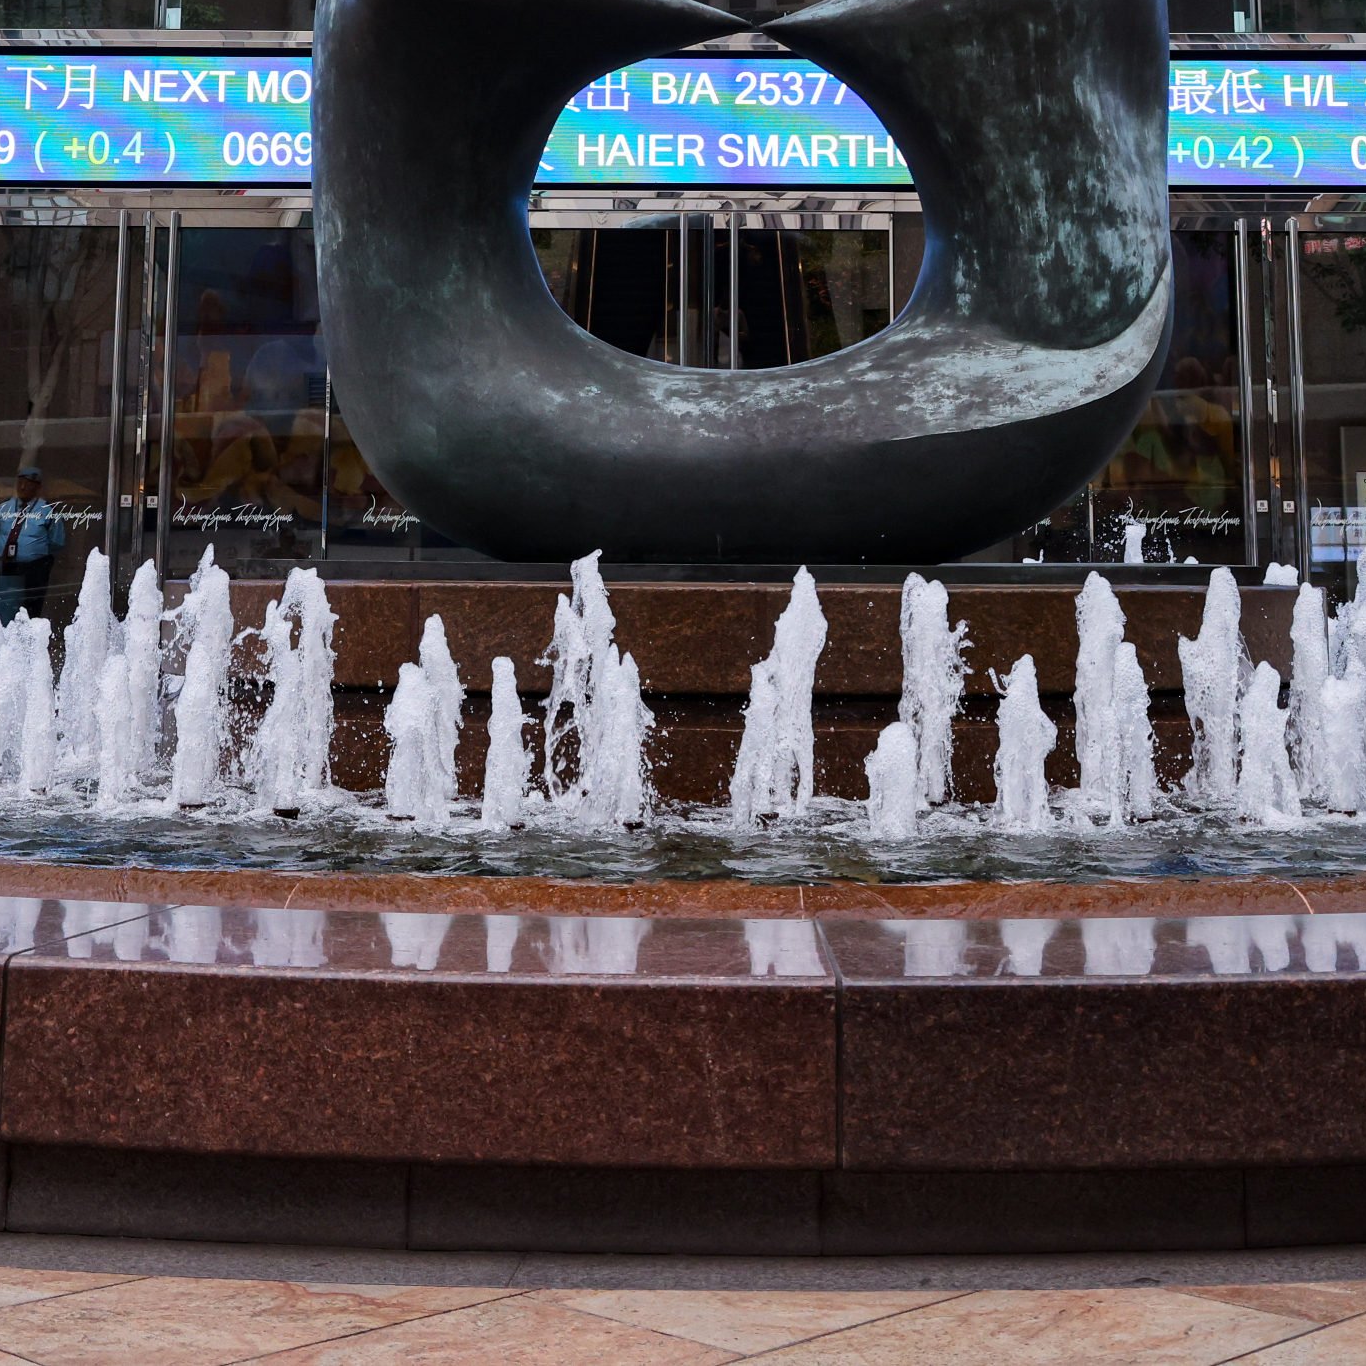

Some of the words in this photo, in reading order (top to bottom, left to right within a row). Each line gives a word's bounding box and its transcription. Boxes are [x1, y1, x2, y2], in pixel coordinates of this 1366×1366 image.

[7, 65, 96, 109] 下月
[123, 70, 235, 102] NEXT
[653, 73, 719, 104] B/A
[1284, 75, 1348, 106] H/L
[579, 135, 704, 166] HAIER
